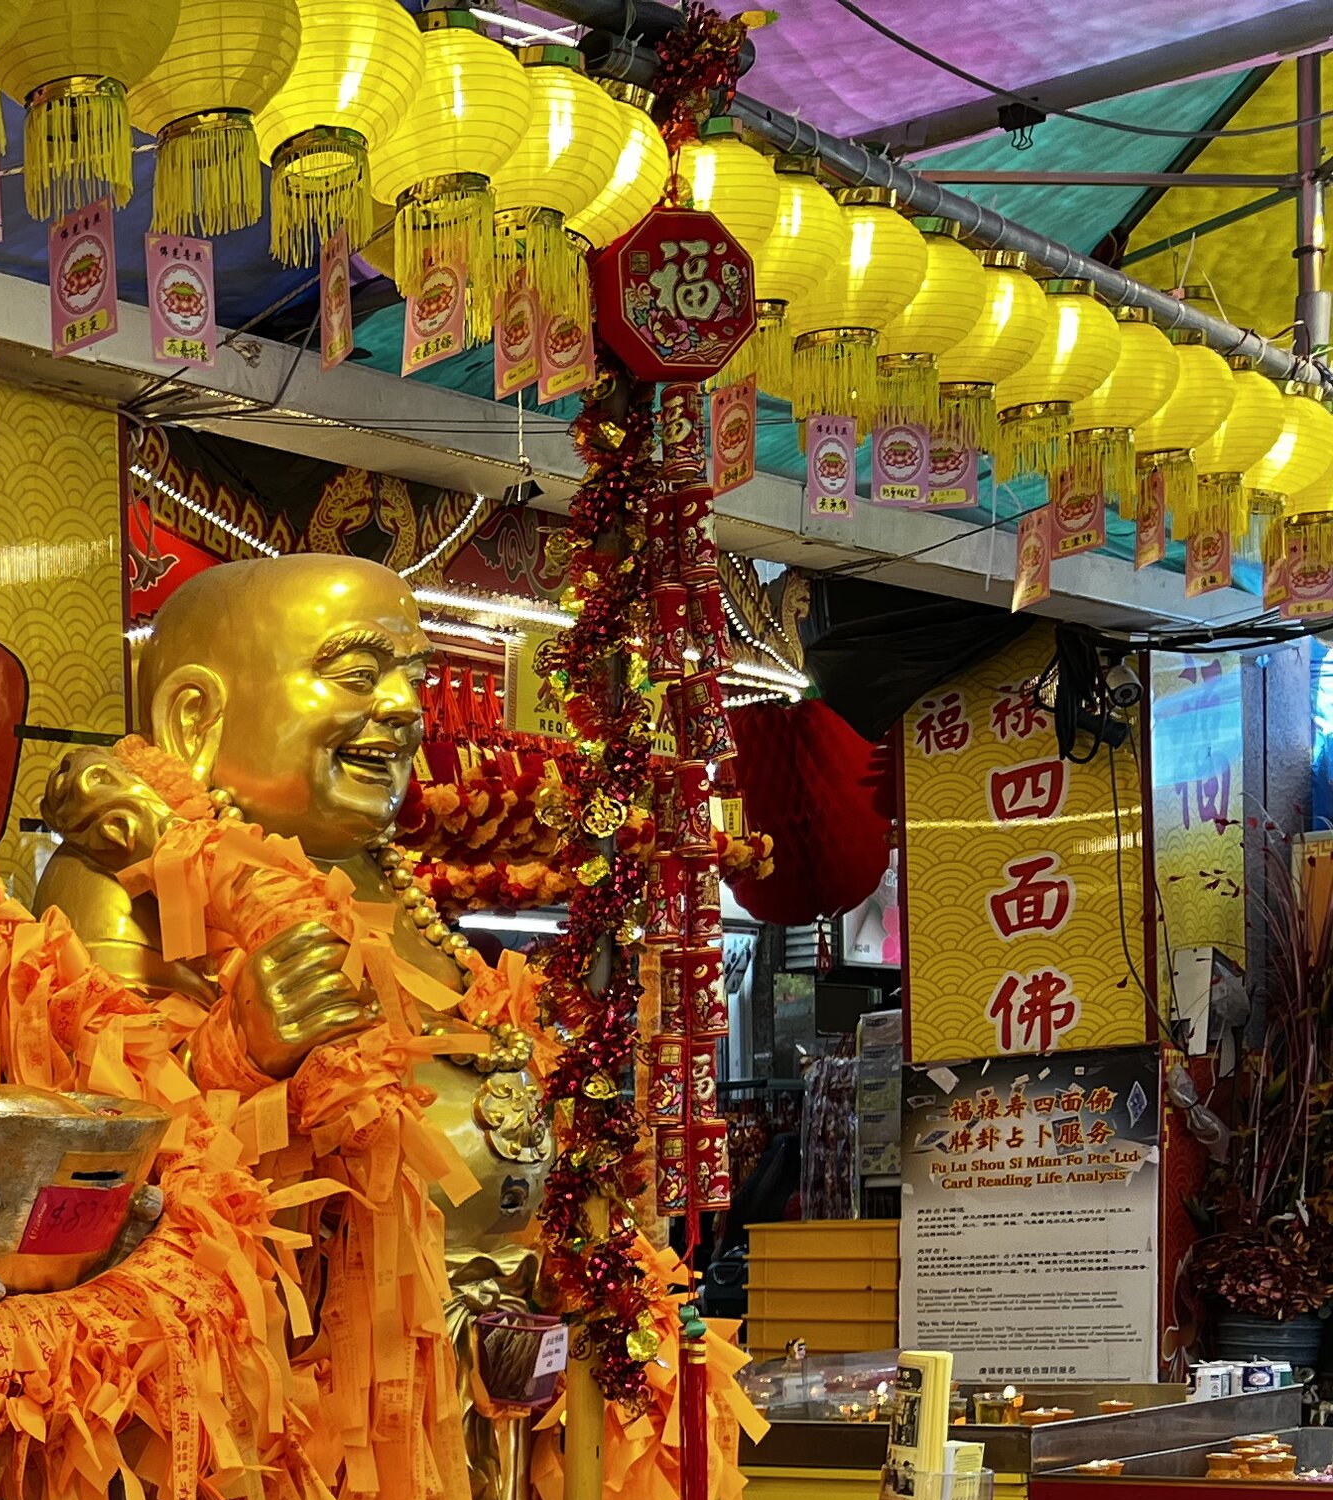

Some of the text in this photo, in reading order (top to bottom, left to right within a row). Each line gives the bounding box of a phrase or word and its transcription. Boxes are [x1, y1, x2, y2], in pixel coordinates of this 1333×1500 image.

[649, 239, 722, 321] 福
[989, 759, 1075, 1052] 四面佛
[932, 1162, 947, 1174] Fu
[951, 1160, 967, 1172] Lu
[971, 1157, 1005, 1171] Shou
[1009, 1156, 1023, 1168] Si
[1026, 1154, 1062, 1168] Mian
[1066, 1152, 1083, 1165] Fo
[1088, 1150, 1111, 1163] Pte
[941, 1169, 1127, 1190] Card Reading Life Analysis
